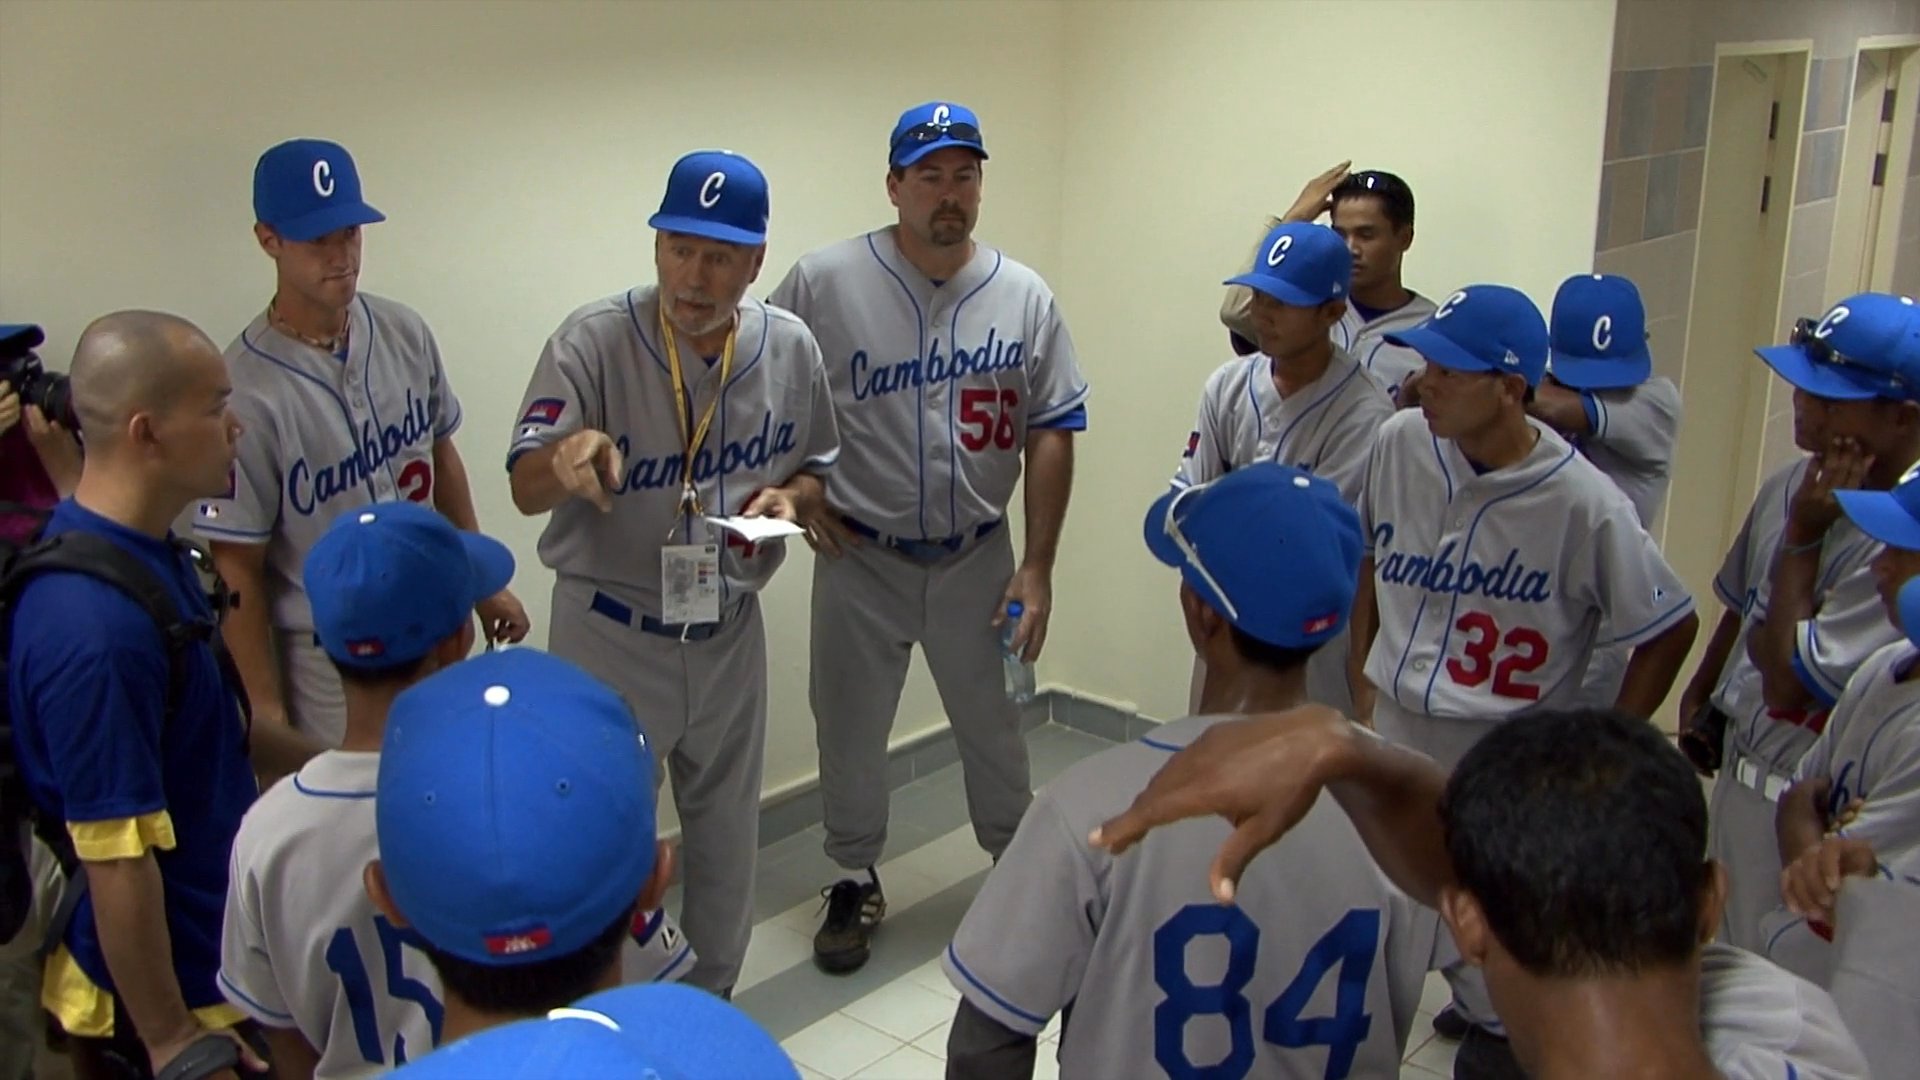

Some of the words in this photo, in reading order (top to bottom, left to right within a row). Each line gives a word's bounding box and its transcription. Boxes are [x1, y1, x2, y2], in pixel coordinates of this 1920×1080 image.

[312, 159, 335, 197] C
[700, 171, 726, 208] C
[1267, 234, 1293, 268] C
[1434, 290, 1467, 319] C
[1591, 314, 1612, 351] C
[1814, 306, 1850, 339] C
[851, 327, 1024, 400] Cambodia
[288, 387, 432, 516] Cambodi
[613, 410, 796, 495] Camboda
[960, 388, 1018, 452] 56
[1374, 522, 1551, 604] Cambodia
[1446, 610, 1549, 700] 32
[325, 914, 446, 1068] 15
[1154, 904, 1381, 1080] 84
